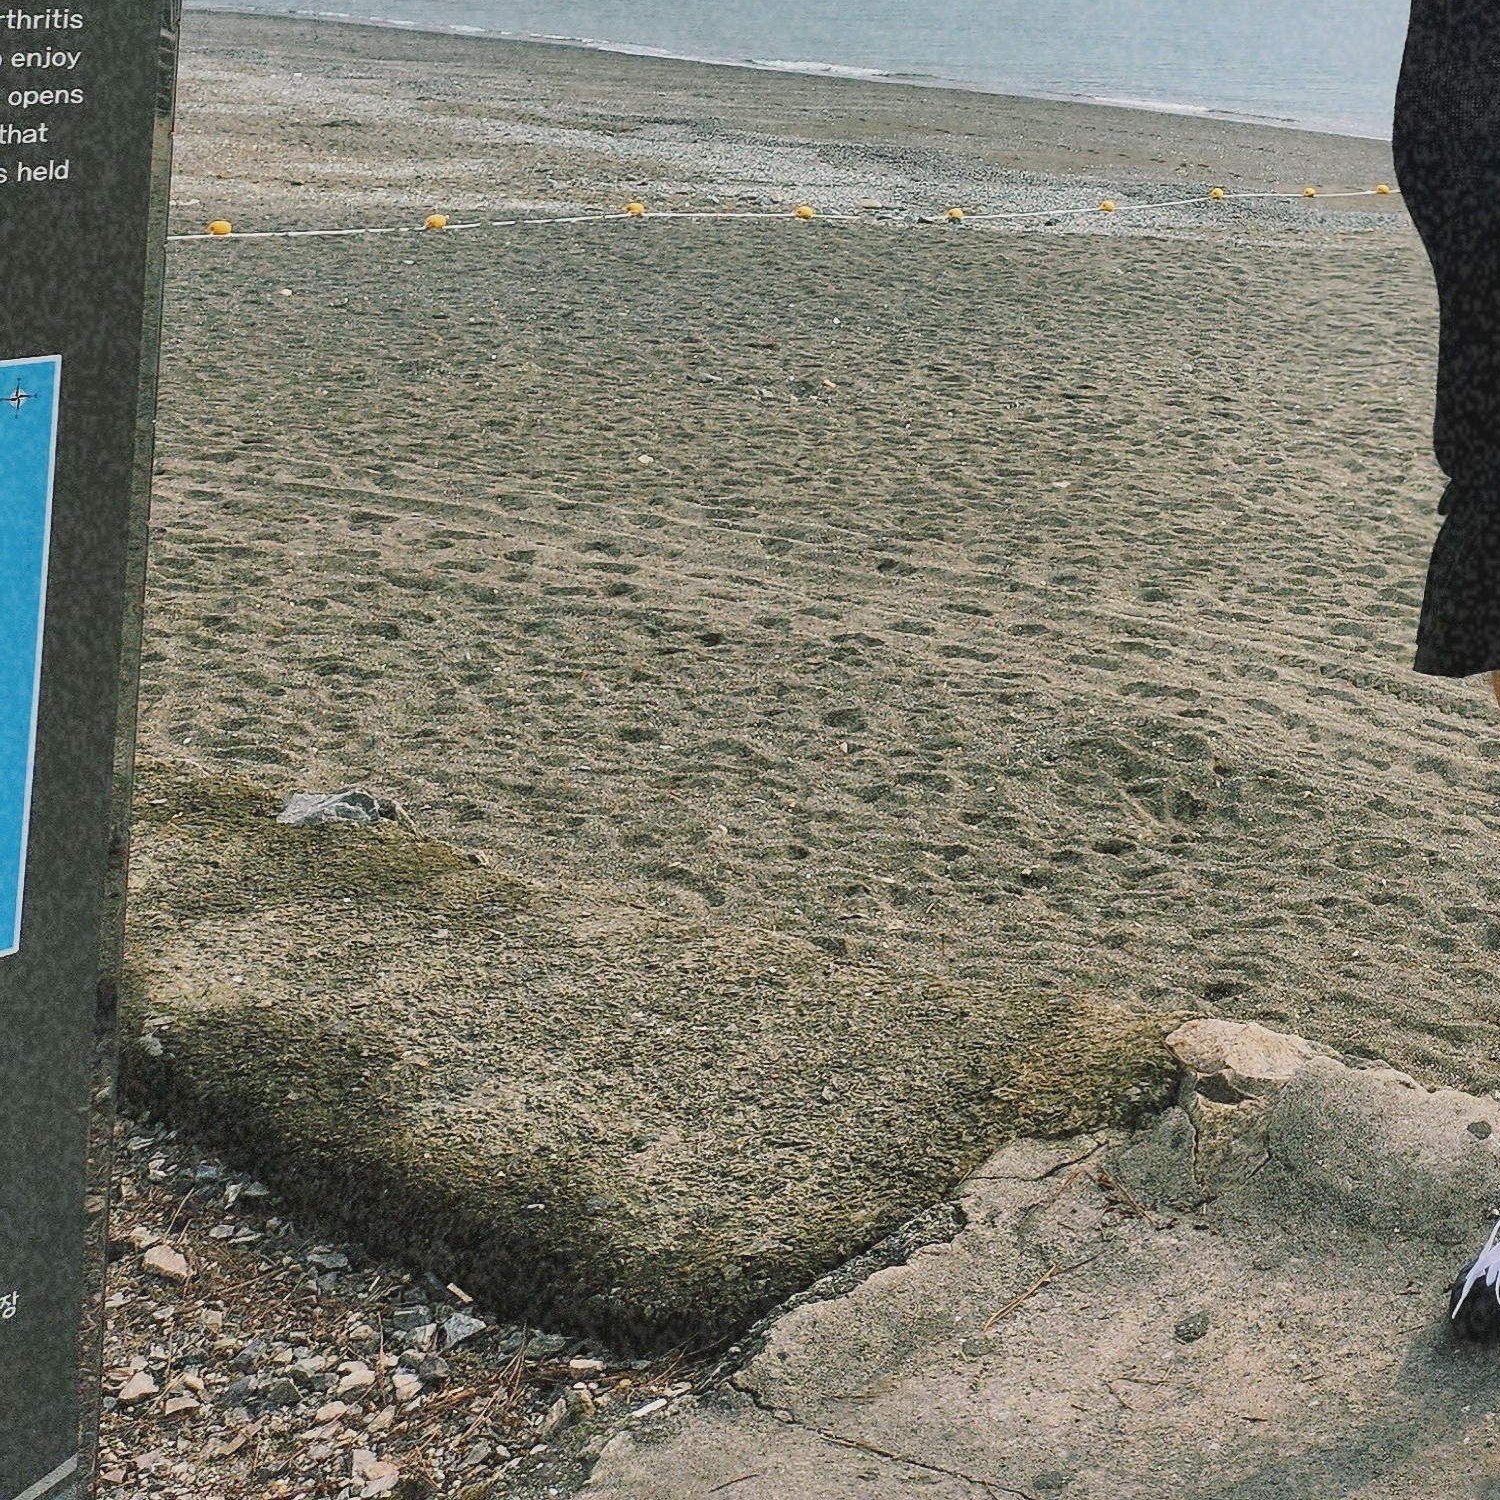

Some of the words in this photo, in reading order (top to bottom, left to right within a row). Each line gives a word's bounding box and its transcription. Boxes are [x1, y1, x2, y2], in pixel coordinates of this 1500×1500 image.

[11, 46, 82, 70] enjoy
[8, 88, 84, 109] opens
[0, 122, 49, 145] that
[17, 159, 70, 182] held
